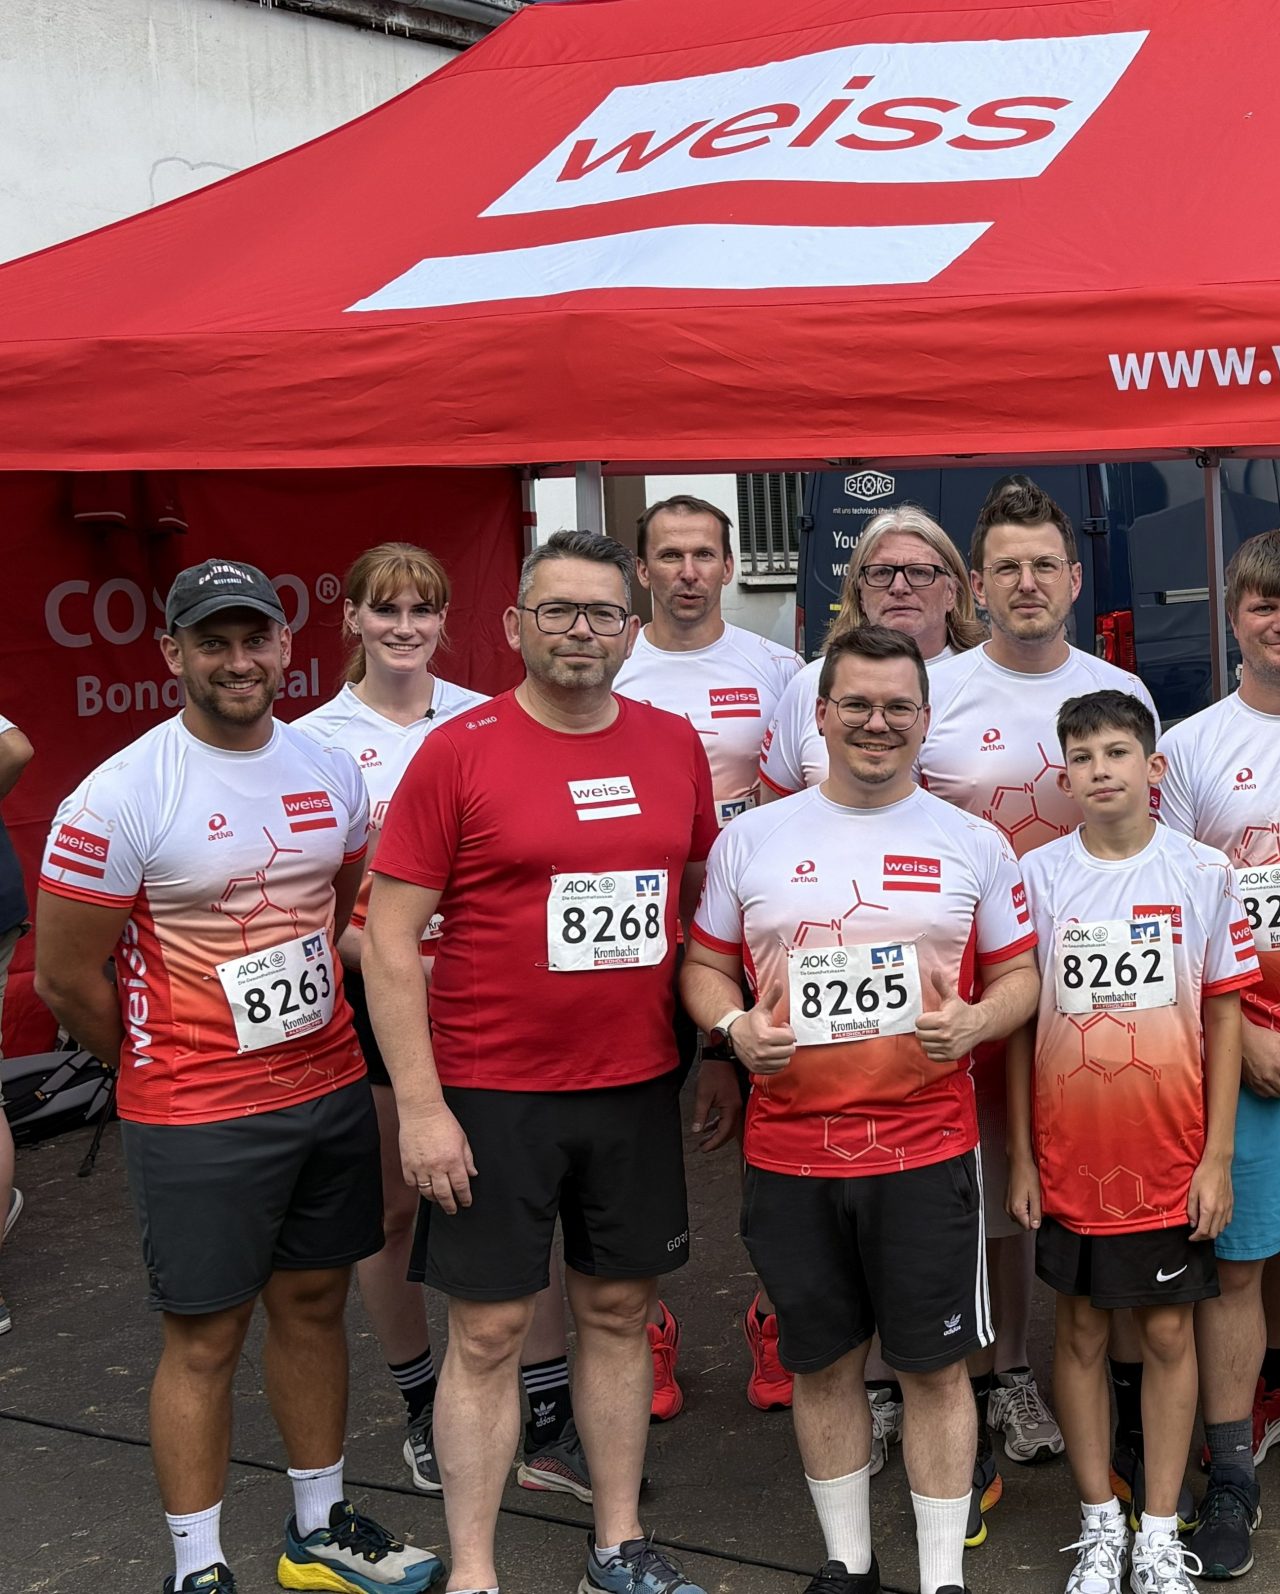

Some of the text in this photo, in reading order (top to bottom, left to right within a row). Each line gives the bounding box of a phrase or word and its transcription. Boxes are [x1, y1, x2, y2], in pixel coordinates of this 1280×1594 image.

[556, 75, 1072, 182] weiss
[711, 691, 757, 702] weiss
[477, 716, 498, 727] JAKO
[573, 784, 631, 799] weiss
[285, 796, 331, 812] weiss
[208, 830, 234, 841] artiva
[58, 831, 105, 857] weiss
[886, 860, 939, 874] weiss
[1239, 872, 1268, 885] AOK
[563, 880, 597, 893] AOK
[562, 903, 660, 944] 8268
[1063, 930, 1091, 941] AOK
[594, 946, 639, 958] Krombacher
[236, 957, 270, 978] AOK
[800, 954, 830, 968] AOK
[1063, 949, 1164, 989] 8262
[244, 963, 330, 1024] 8263
[801, 973, 908, 1018] 8265
[1092, 991, 1136, 1003] Krombacher
[282, 1009, 322, 1031] Krombacher
[831, 1017, 880, 1032] Krombacher
